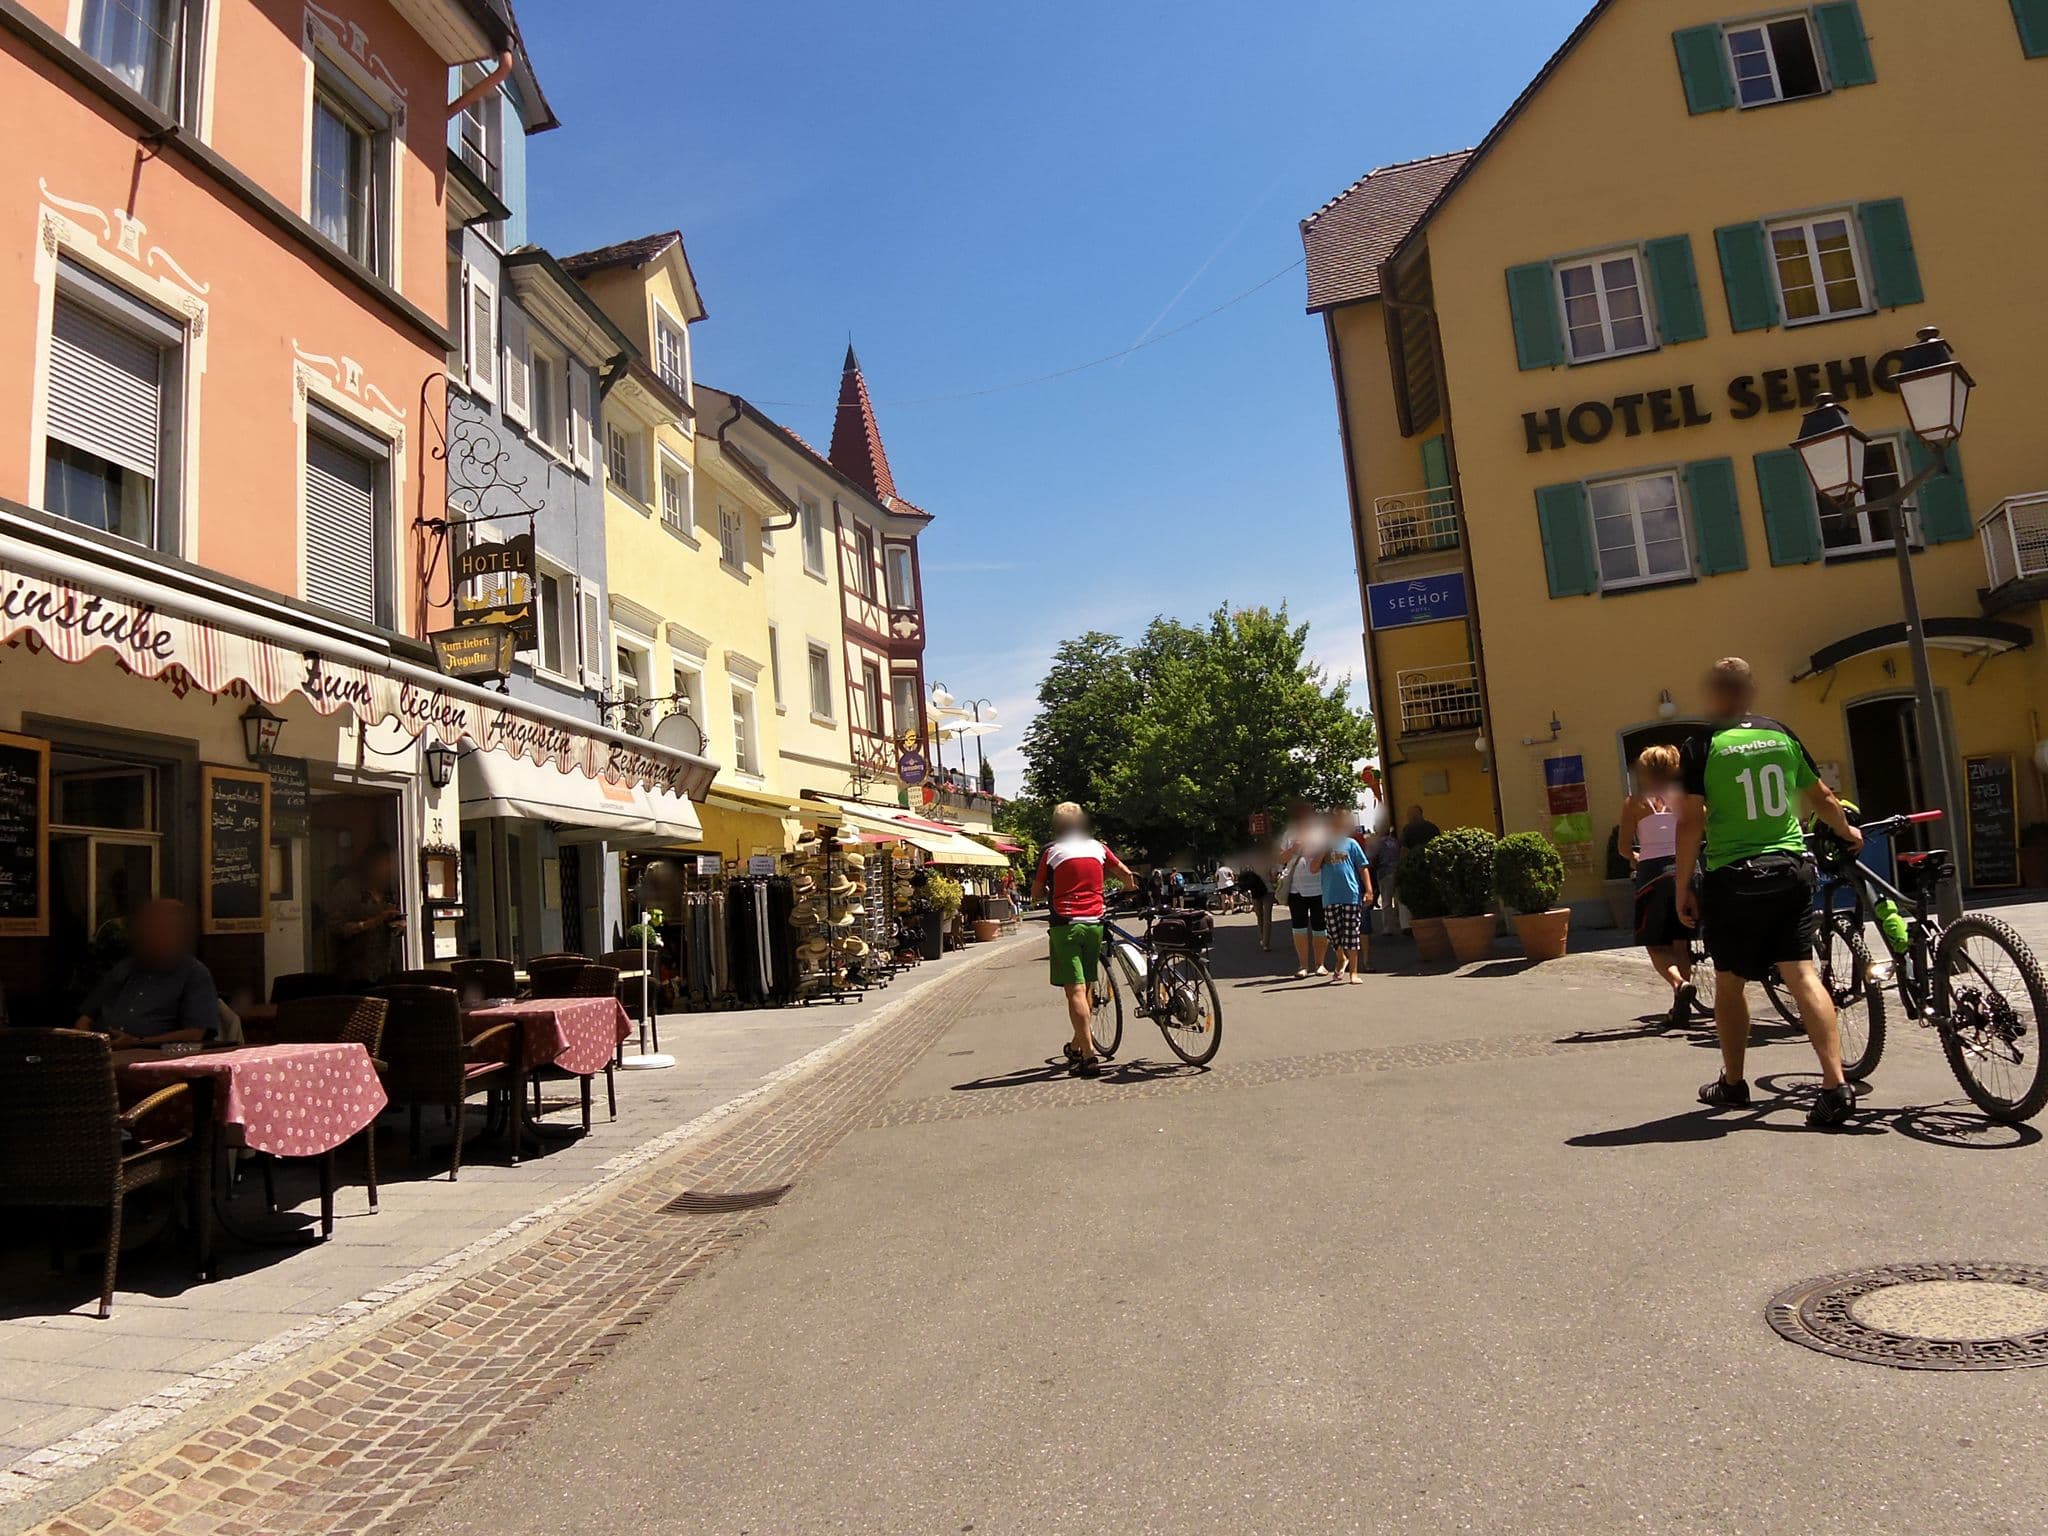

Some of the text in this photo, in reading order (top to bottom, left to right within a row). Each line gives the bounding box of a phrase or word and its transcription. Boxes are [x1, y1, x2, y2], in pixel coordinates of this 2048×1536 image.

[1521, 349, 1905, 453] HOTEL SEEHO
[462, 550, 525, 574] HOTEL
[1389, 591, 1449, 610] SEEHOF
[0, 579, 174, 659] instube
[301, 650, 372, 706] Zum
[400, 683, 467, 729] lieben
[488, 707, 572, 756] Augustin
[606, 740, 682, 785] Restaurant
[1721, 739, 1777, 756] skyvibe
[1735, 763, 1787, 820] 10
[432, 817, 443, 834] 35
